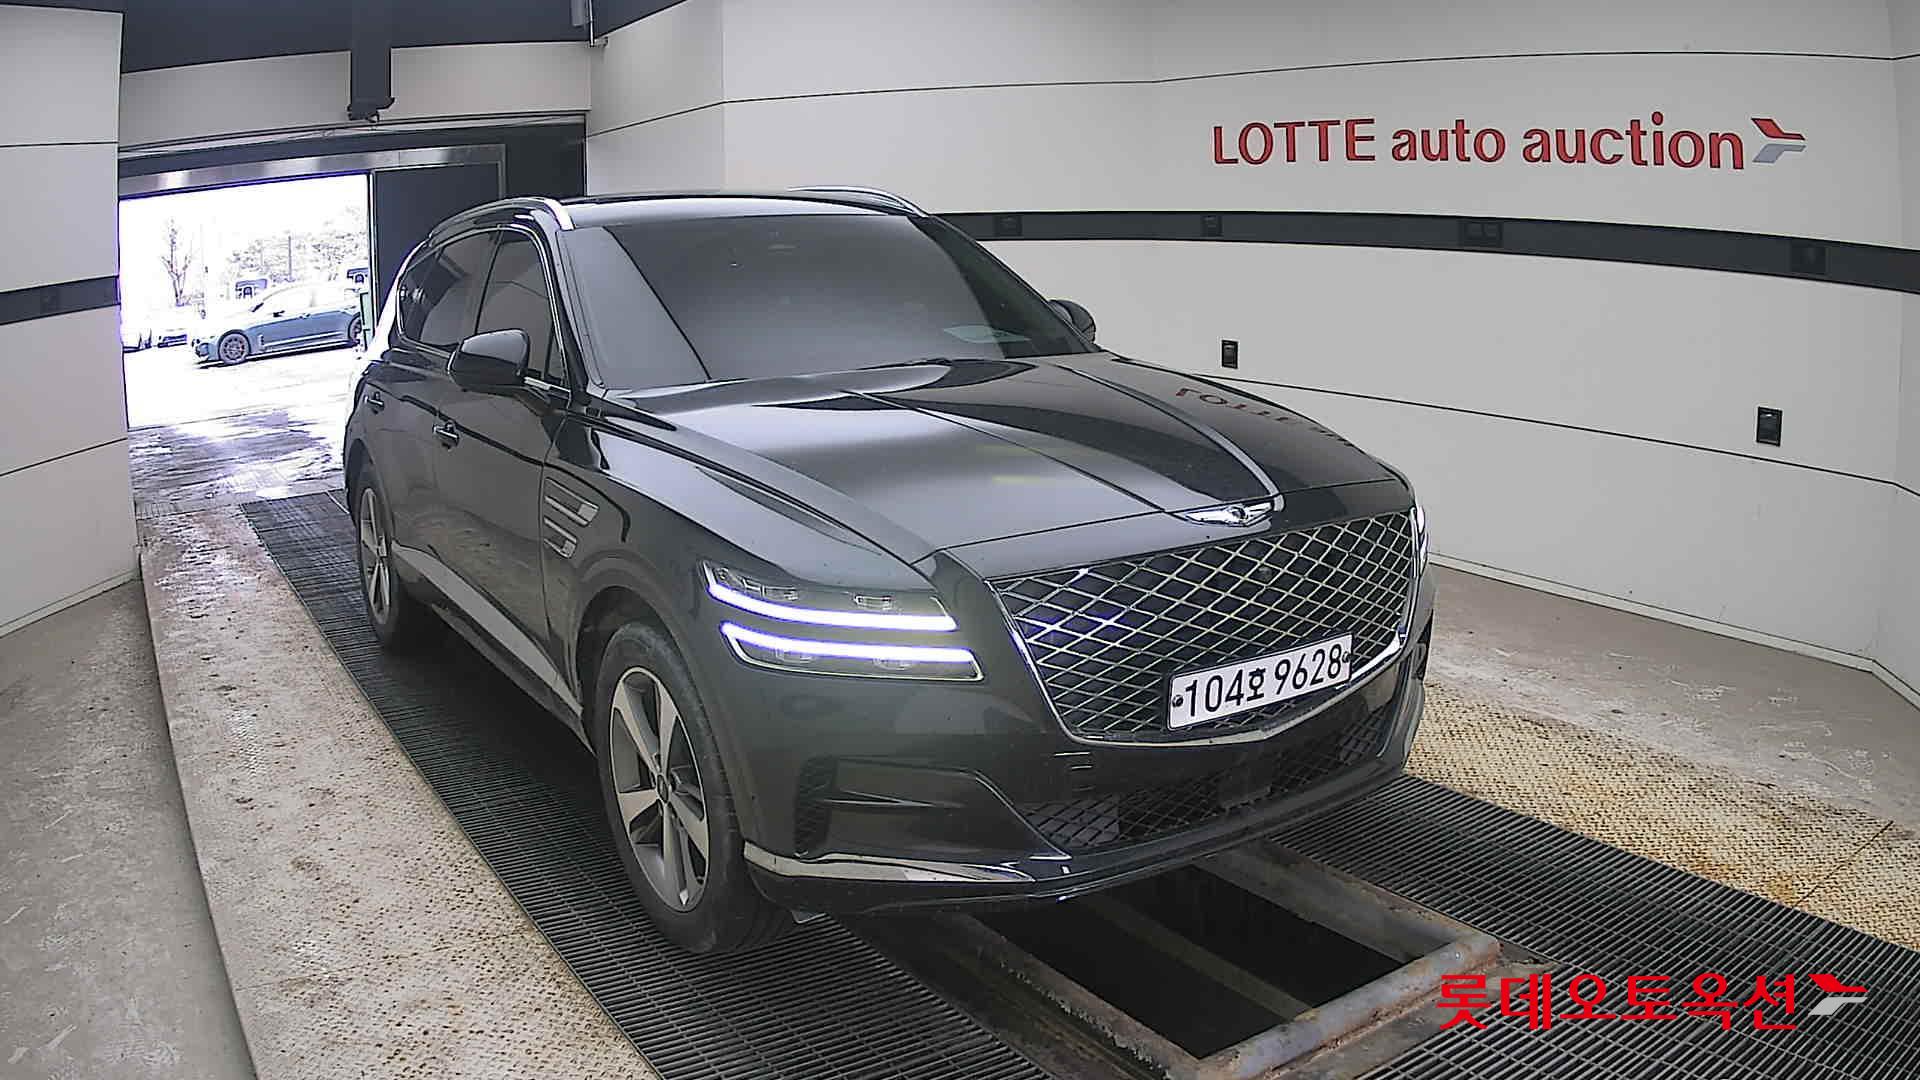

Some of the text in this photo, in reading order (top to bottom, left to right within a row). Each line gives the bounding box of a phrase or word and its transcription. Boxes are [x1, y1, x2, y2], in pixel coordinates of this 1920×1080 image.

[1213, 111, 1746, 173] LOTTE auto auction
[1185, 643, 1342, 717] 104호 9628
